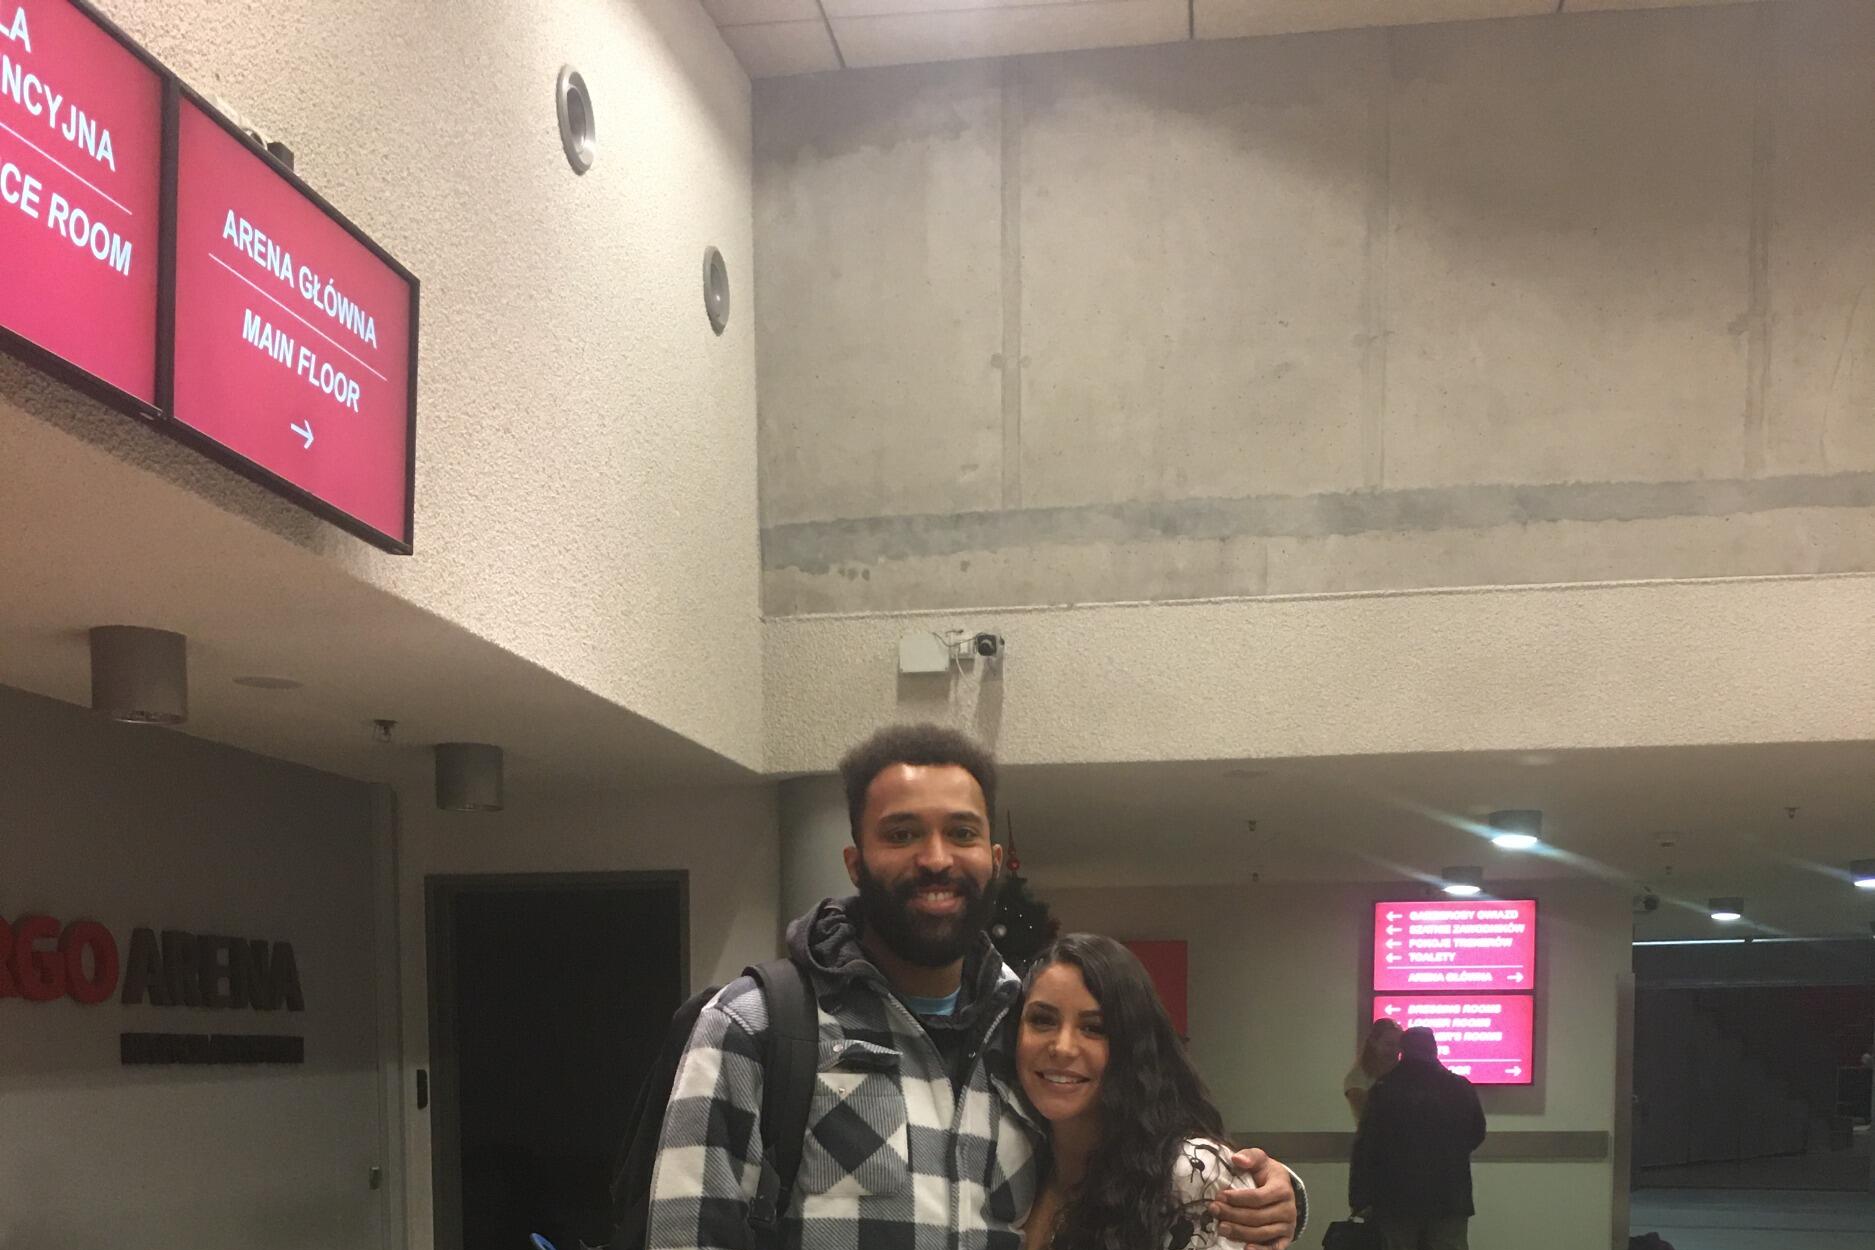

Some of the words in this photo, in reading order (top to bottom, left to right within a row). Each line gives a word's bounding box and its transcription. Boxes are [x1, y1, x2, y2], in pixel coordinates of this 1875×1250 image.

[1, 54, 116, 172] NCYJNA
[0, 163, 41, 219] CE
[47, 194, 132, 276] ROOM
[222, 208, 295, 288] ARENA
[299, 266, 378, 349] GŁÓWNA
[242, 309, 294, 368] MAIN
[297, 346, 361, 413] FLOOR
[121, 927, 305, 1011] ARENA
